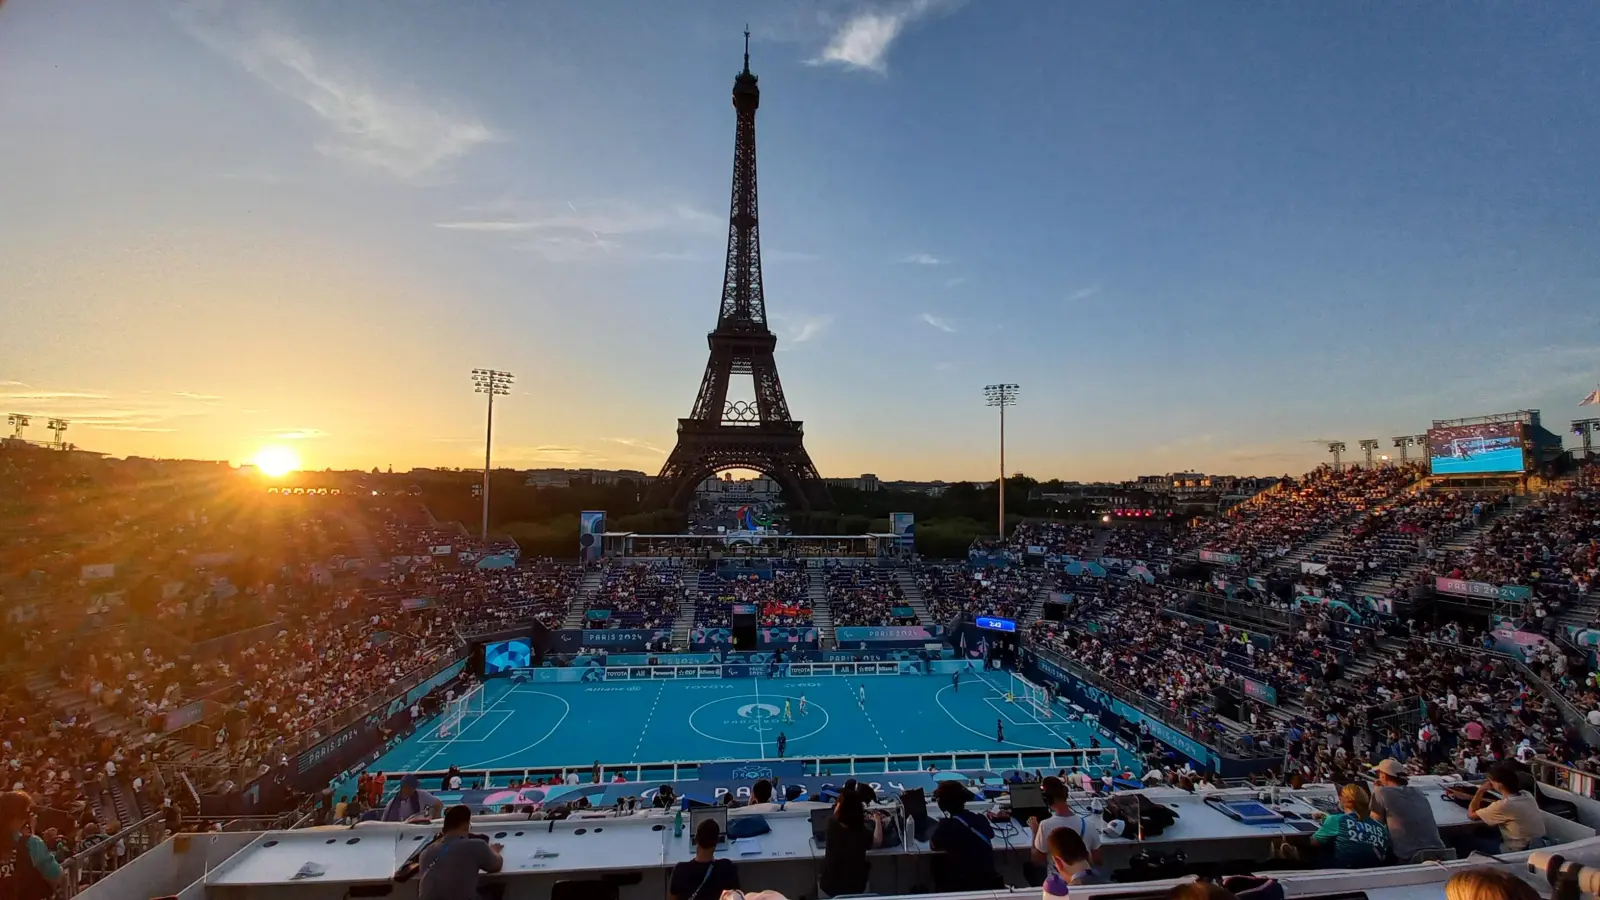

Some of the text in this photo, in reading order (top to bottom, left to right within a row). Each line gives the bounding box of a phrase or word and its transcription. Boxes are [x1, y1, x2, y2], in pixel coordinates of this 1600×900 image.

[1447, 581, 1516, 598] PARIS 2024
[618, 633, 643, 641] 2024
[895, 629, 919, 637] 2024
[862, 654, 881, 662] 024
[308, 728, 358, 765] PARIS 2024
[1172, 736, 1196, 755] 2024
[714, 784, 808, 799] PAIS
[1346, 818, 1383, 837] PARIS
